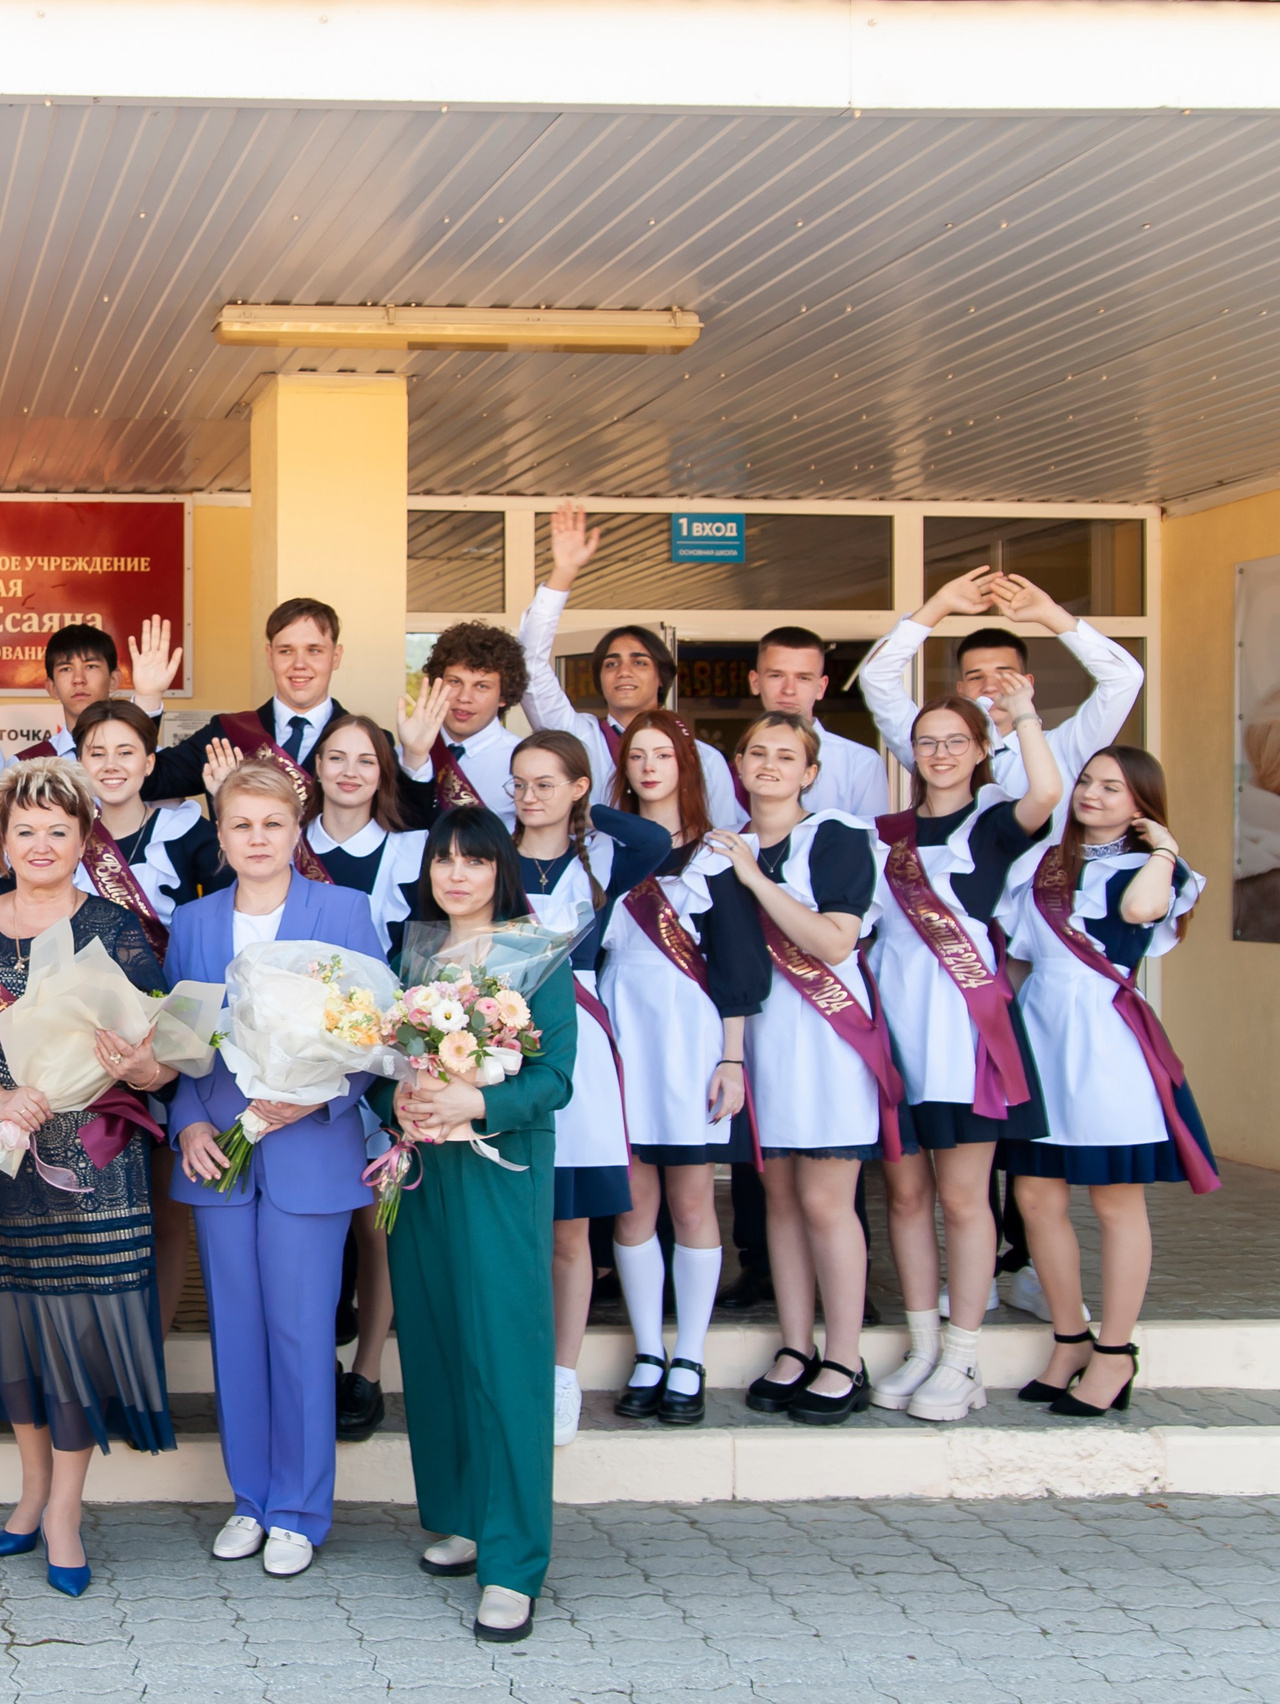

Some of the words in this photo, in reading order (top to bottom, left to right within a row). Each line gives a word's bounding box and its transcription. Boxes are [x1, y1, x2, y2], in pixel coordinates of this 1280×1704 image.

[678, 517, 688, 536] 1
[692, 522, 738, 537] ВХОД
[679, 548, 715, 556] ОСНОВНАЯ
[25, 556, 151, 574] УЧРЕЖДЕНИЕ
[943, 951, 995, 990] 2024
[802, 976, 855, 1016] 2024
